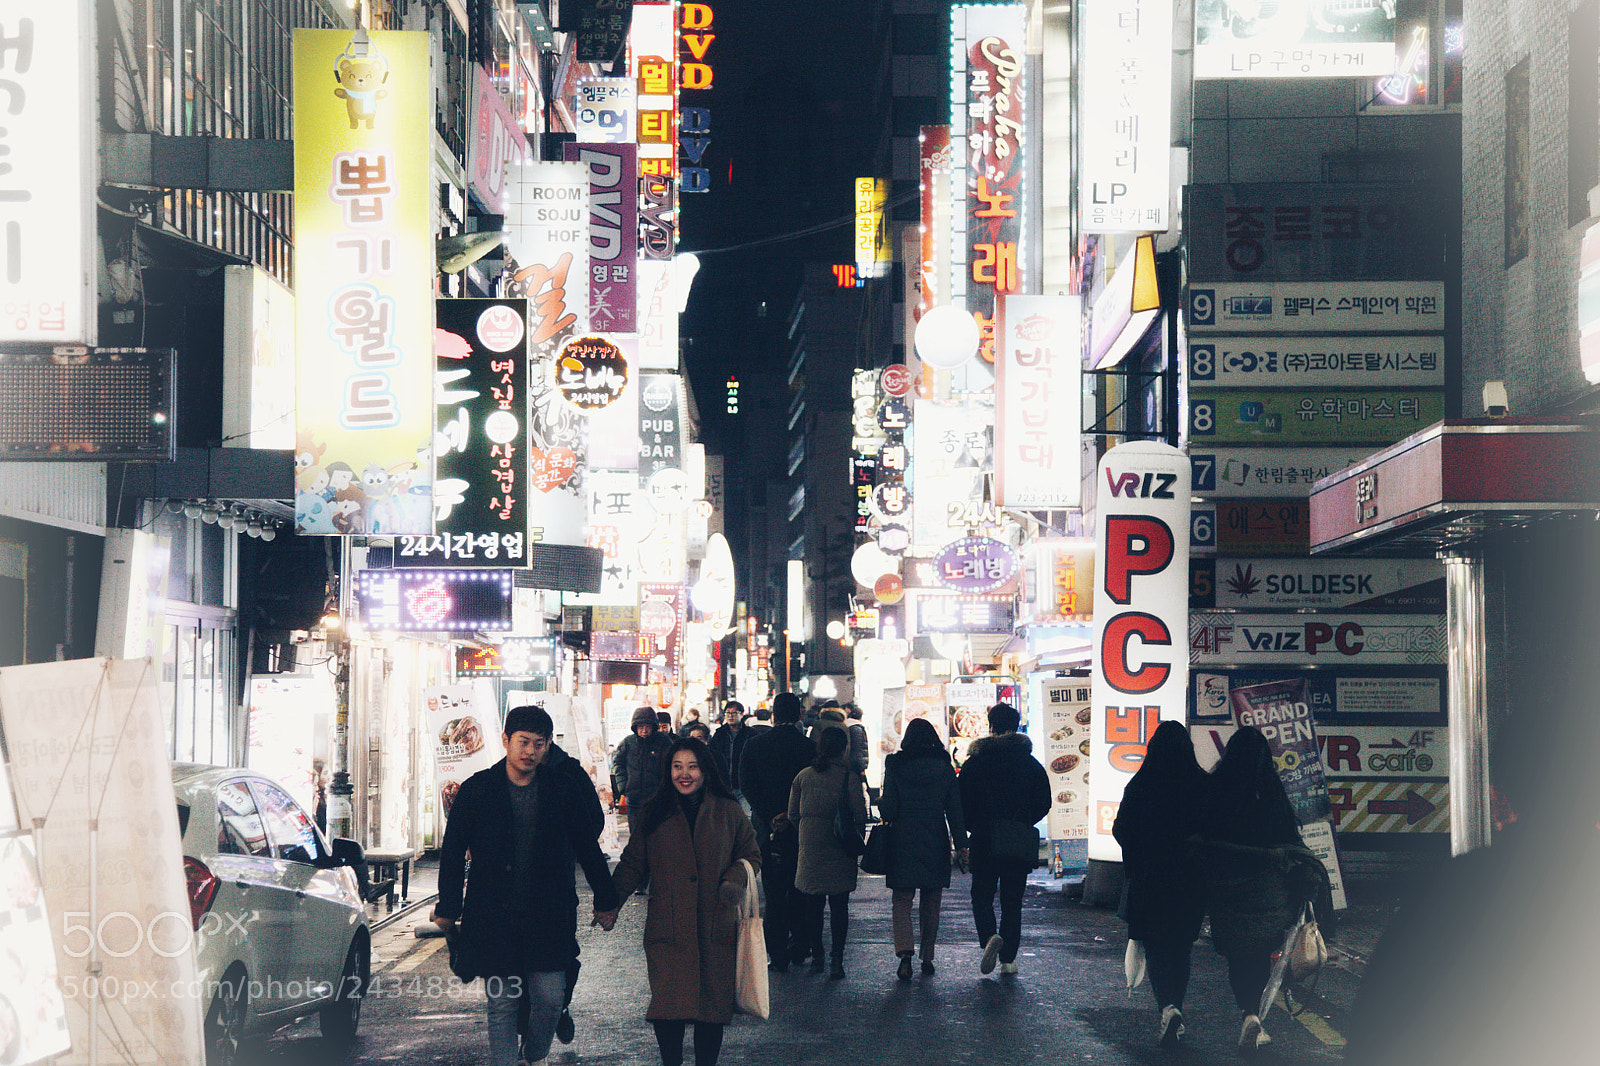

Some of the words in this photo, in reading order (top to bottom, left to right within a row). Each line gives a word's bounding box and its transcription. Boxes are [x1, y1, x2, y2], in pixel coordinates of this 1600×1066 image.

[680, 3, 714, 90] DVD
[1231, 53, 1261, 71] LP
[1270, 50, 1313, 73] 구멍
[1318, 53, 1365, 66] 가게
[582, 86, 634, 103] 엠플러스
[978, 36, 1021, 160] Praha
[680, 107, 712, 193] DVD
[533, 187, 581, 200] ROOM
[579, 149, 622, 261] DVD
[1092, 182, 1128, 205] LP
[537, 208, 581, 221] SOJU
[640, 174, 675, 260] DVD
[858, 182, 874, 250] 유리공간
[1092, 207, 1161, 224] 음악카페
[547, 229, 580, 242] HOF
[1193, 294, 1213, 320] 9
[1283, 296, 1331, 315] 펠리스
[1336, 296, 1400, 315] 스페인어
[1405, 296, 1438, 315] 학원
[594, 320, 610, 330] 3F
[1193, 349, 1213, 376] 8
[1283, 352, 1438, 372] (주)코아토탈시스템
[641, 420, 674, 432] PUB
[1193, 404, 1213, 431] 8
[1296, 398, 1421, 422] 유학마스터
[653, 433, 662, 443] &
[939, 430, 984, 453] 종로
[549, 453, 575, 468] 문화
[641, 445, 674, 457] BAR
[883, 404, 907, 512] 노래방
[490, 443, 516, 520] 삼겹살
[535, 469, 563, 488] 공간
[1106, 467, 1178, 499] VRIZ
[1193, 461, 1213, 487] 7
[1254, 467, 1330, 485] 한림출판사
[1016, 494, 1068, 503] 723-2112
[946, 501, 1003, 527] 24시
[1193, 516, 1212, 542] 6
[400, 531, 523, 559] 24시간영업
[944, 559, 1006, 580] 노래방
[1055, 548, 1079, 616] 노래방
[1193, 570, 1212, 595] 5
[1266, 574, 1374, 595] SOLDESK
[1191, 626, 1234, 654] 4F
[1243, 628, 1301, 651] VRIZ
[1304, 622, 1364, 656] PC
[1366, 627, 1432, 651] cafe
[1050, 689, 1071, 703] 별미
[1077, 688, 1092, 701] 메
[1240, 702, 1309, 728] GRAND
[1262, 719, 1314, 746] PEN
[1406, 730, 1435, 748] 4F
[1368, 753, 1434, 772] cafe
